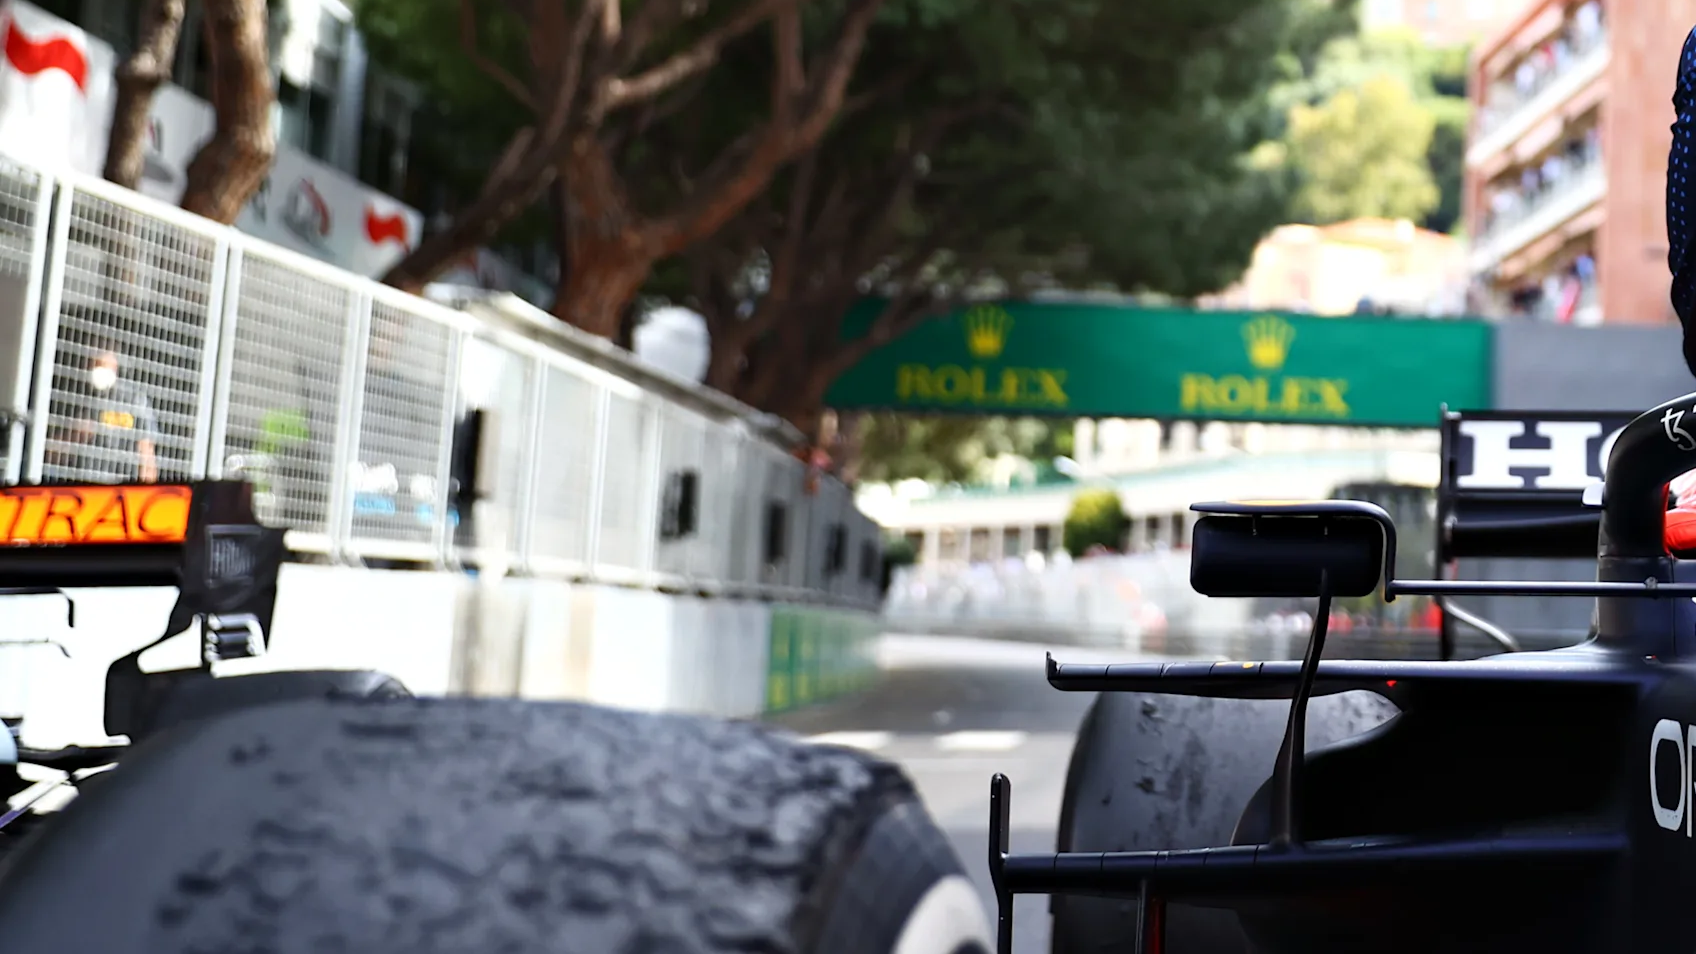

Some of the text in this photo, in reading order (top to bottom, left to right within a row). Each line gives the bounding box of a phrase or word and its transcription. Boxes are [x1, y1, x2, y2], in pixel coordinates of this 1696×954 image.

[896, 364, 1068, 406] ROLEX
[1181, 374, 1349, 415] ROLEX
[1457, 420, 1627, 488] H
[0, 487, 186, 541] TRAC
